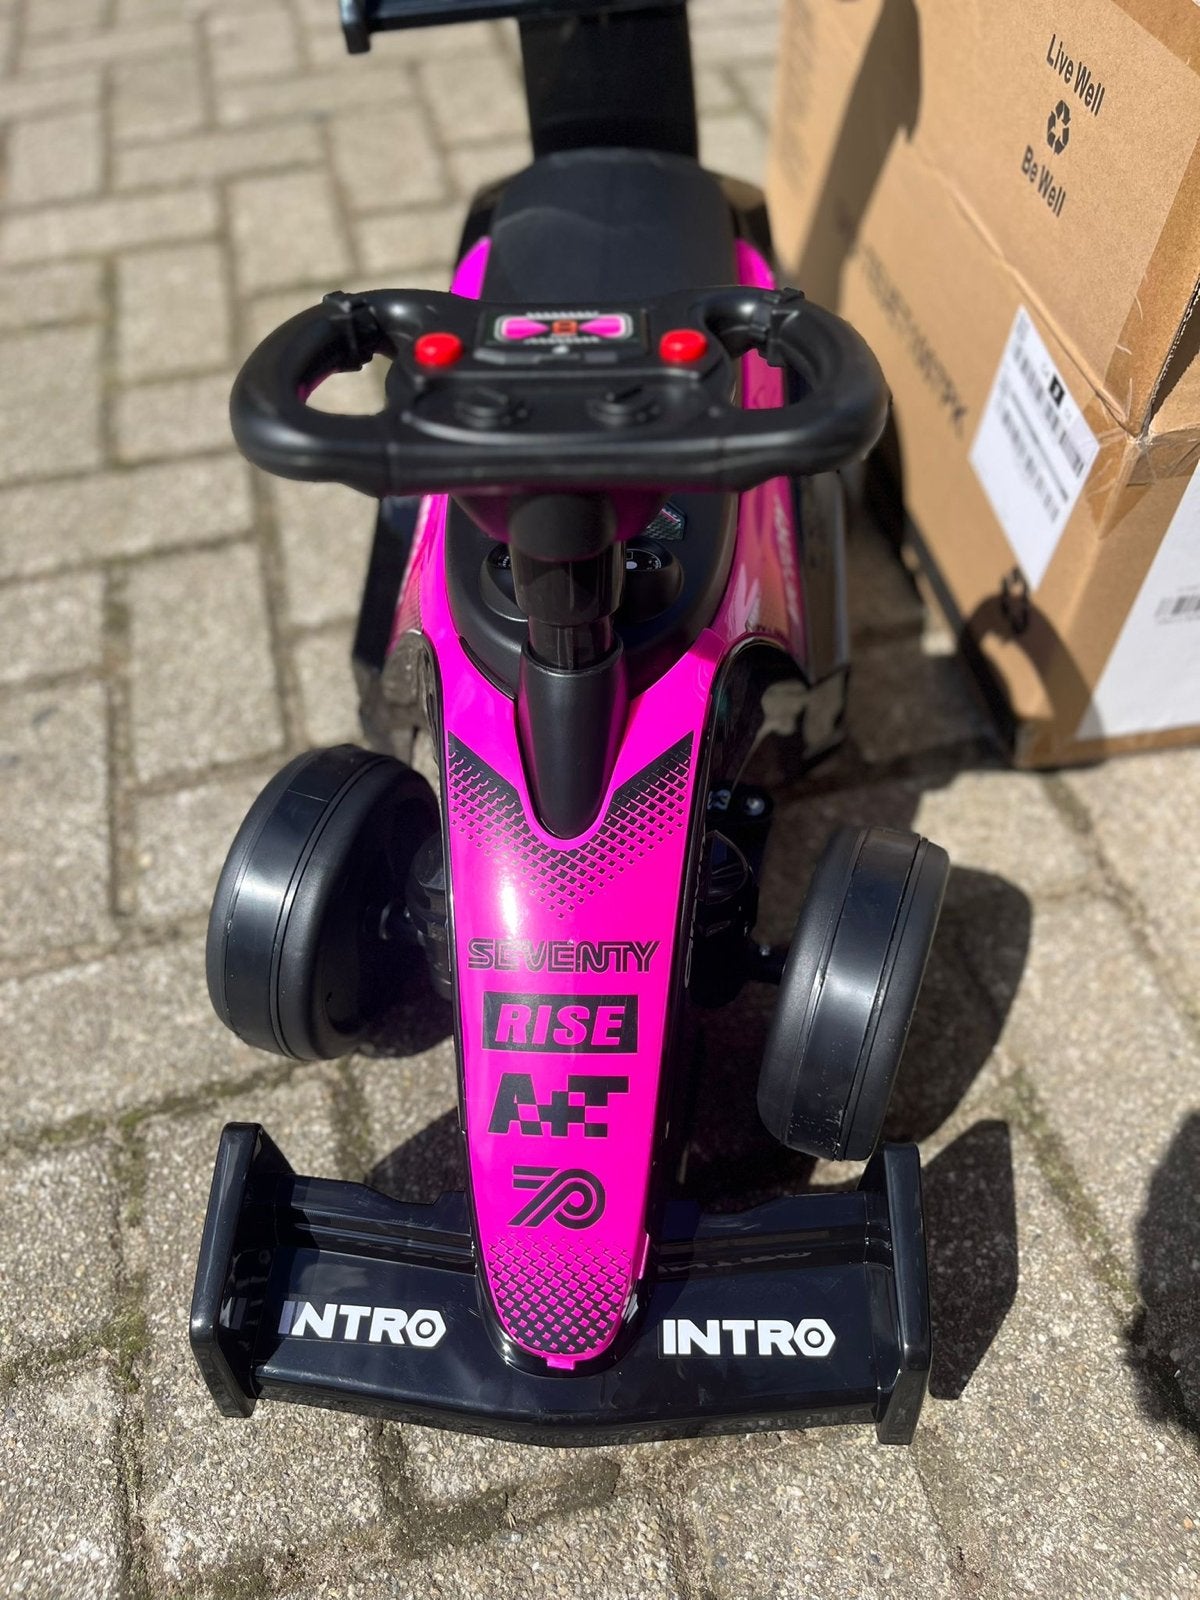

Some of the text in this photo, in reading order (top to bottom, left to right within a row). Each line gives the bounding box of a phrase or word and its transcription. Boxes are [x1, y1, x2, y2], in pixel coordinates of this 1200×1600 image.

[1046, 34, 1105, 117] Live Well
[1021, 144, 1066, 218] Be Well
[467, 938, 661, 973] SEVENTY
[494, 1003, 626, 1046] RISE
[278, 1300, 447, 1348] INTRO
[663, 1318, 837, 1357] INTRO
